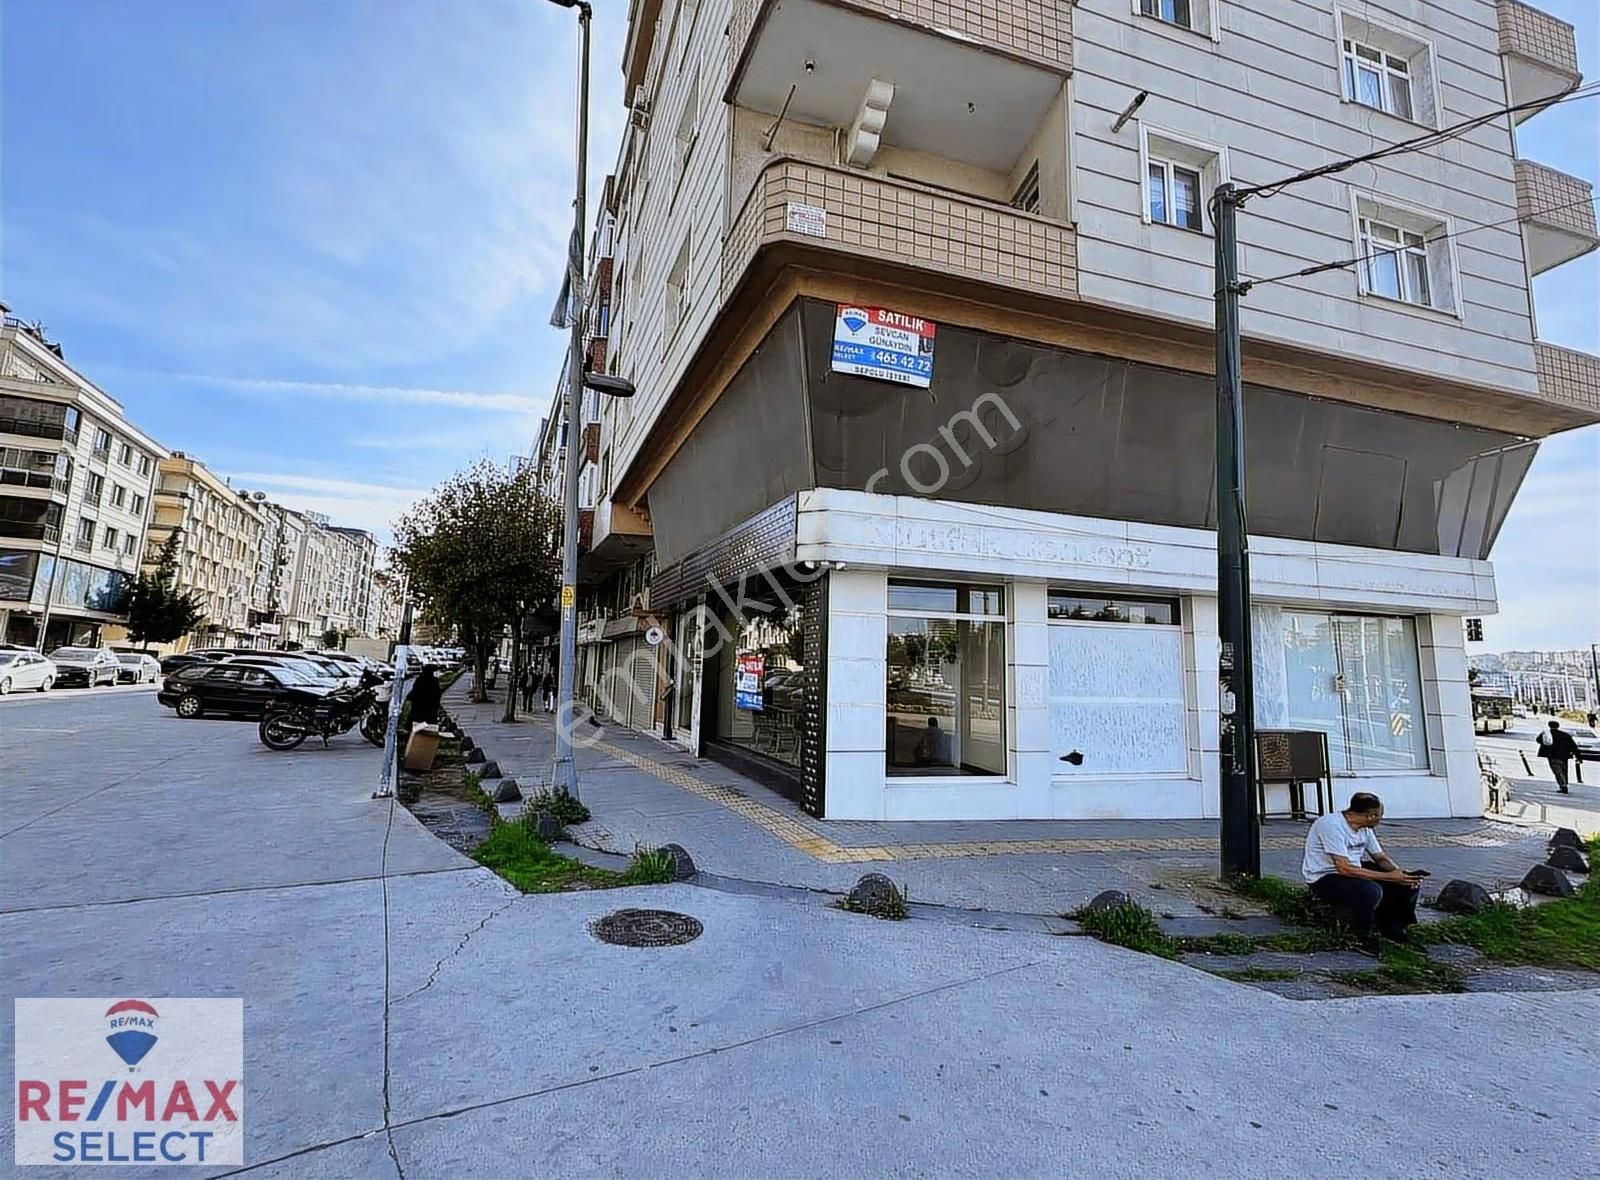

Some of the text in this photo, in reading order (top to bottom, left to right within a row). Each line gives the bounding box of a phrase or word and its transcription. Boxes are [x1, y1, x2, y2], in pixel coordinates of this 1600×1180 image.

[878, 310, 925, 331] SATILIK
[875, 327, 909, 341] SEVCAN
[875, 350, 898, 366] 465
[900, 356, 915, 369] 42
